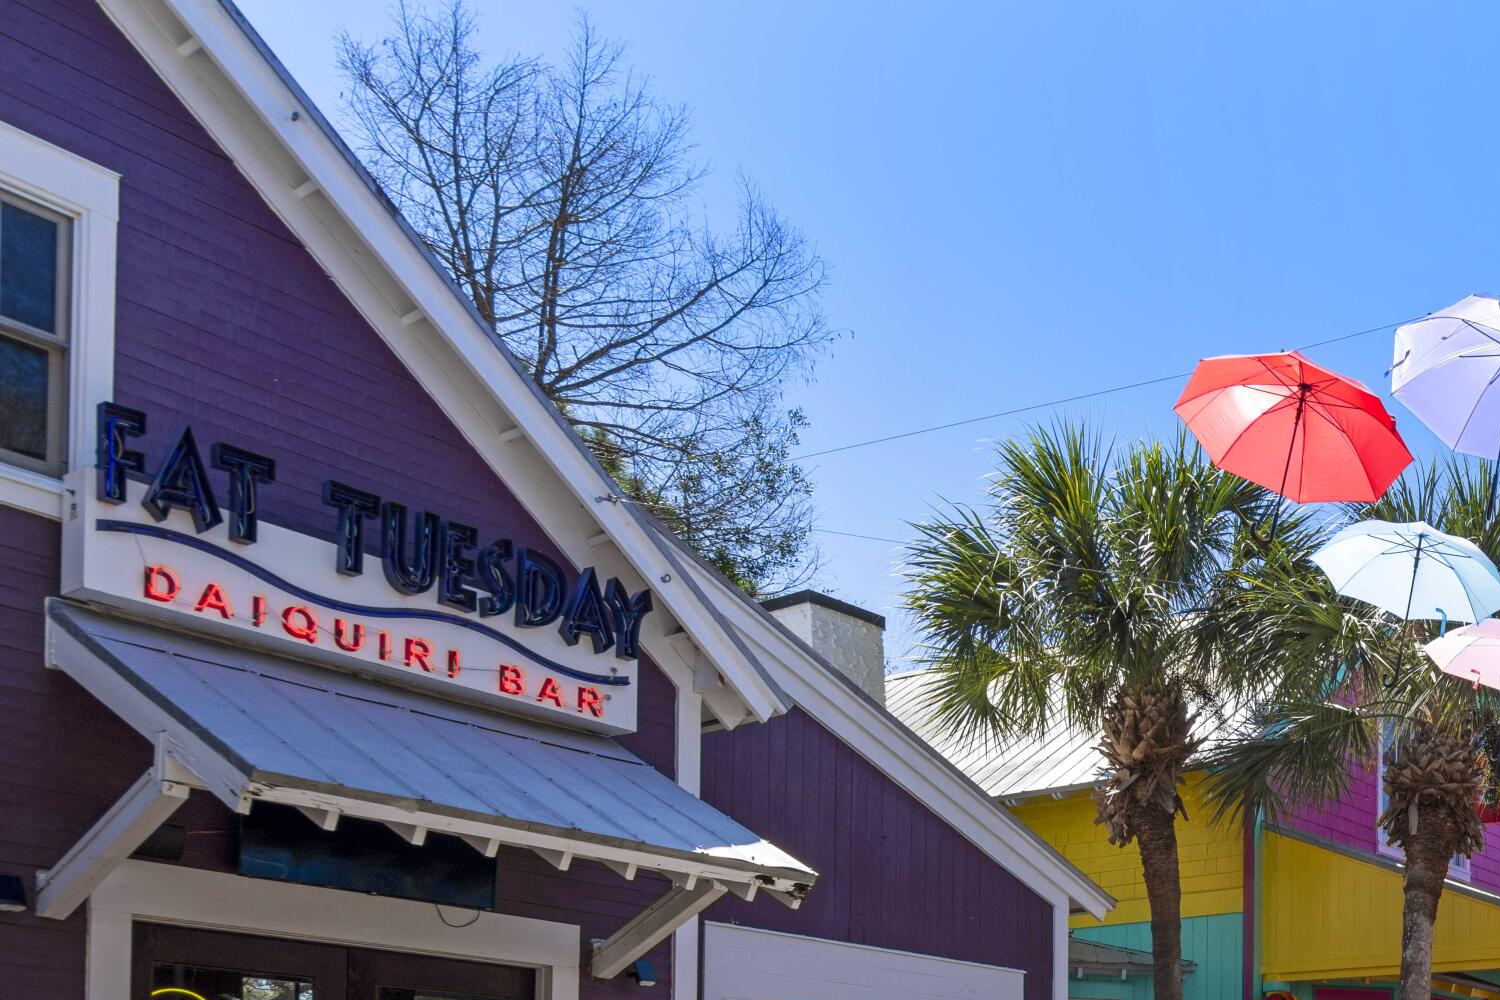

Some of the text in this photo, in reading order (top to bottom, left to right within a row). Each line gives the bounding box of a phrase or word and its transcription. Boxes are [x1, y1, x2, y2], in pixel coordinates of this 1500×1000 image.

[96, 402, 654, 661] FAT TUESDAY
[144, 564, 605, 718] DAIQUIRI BAR
